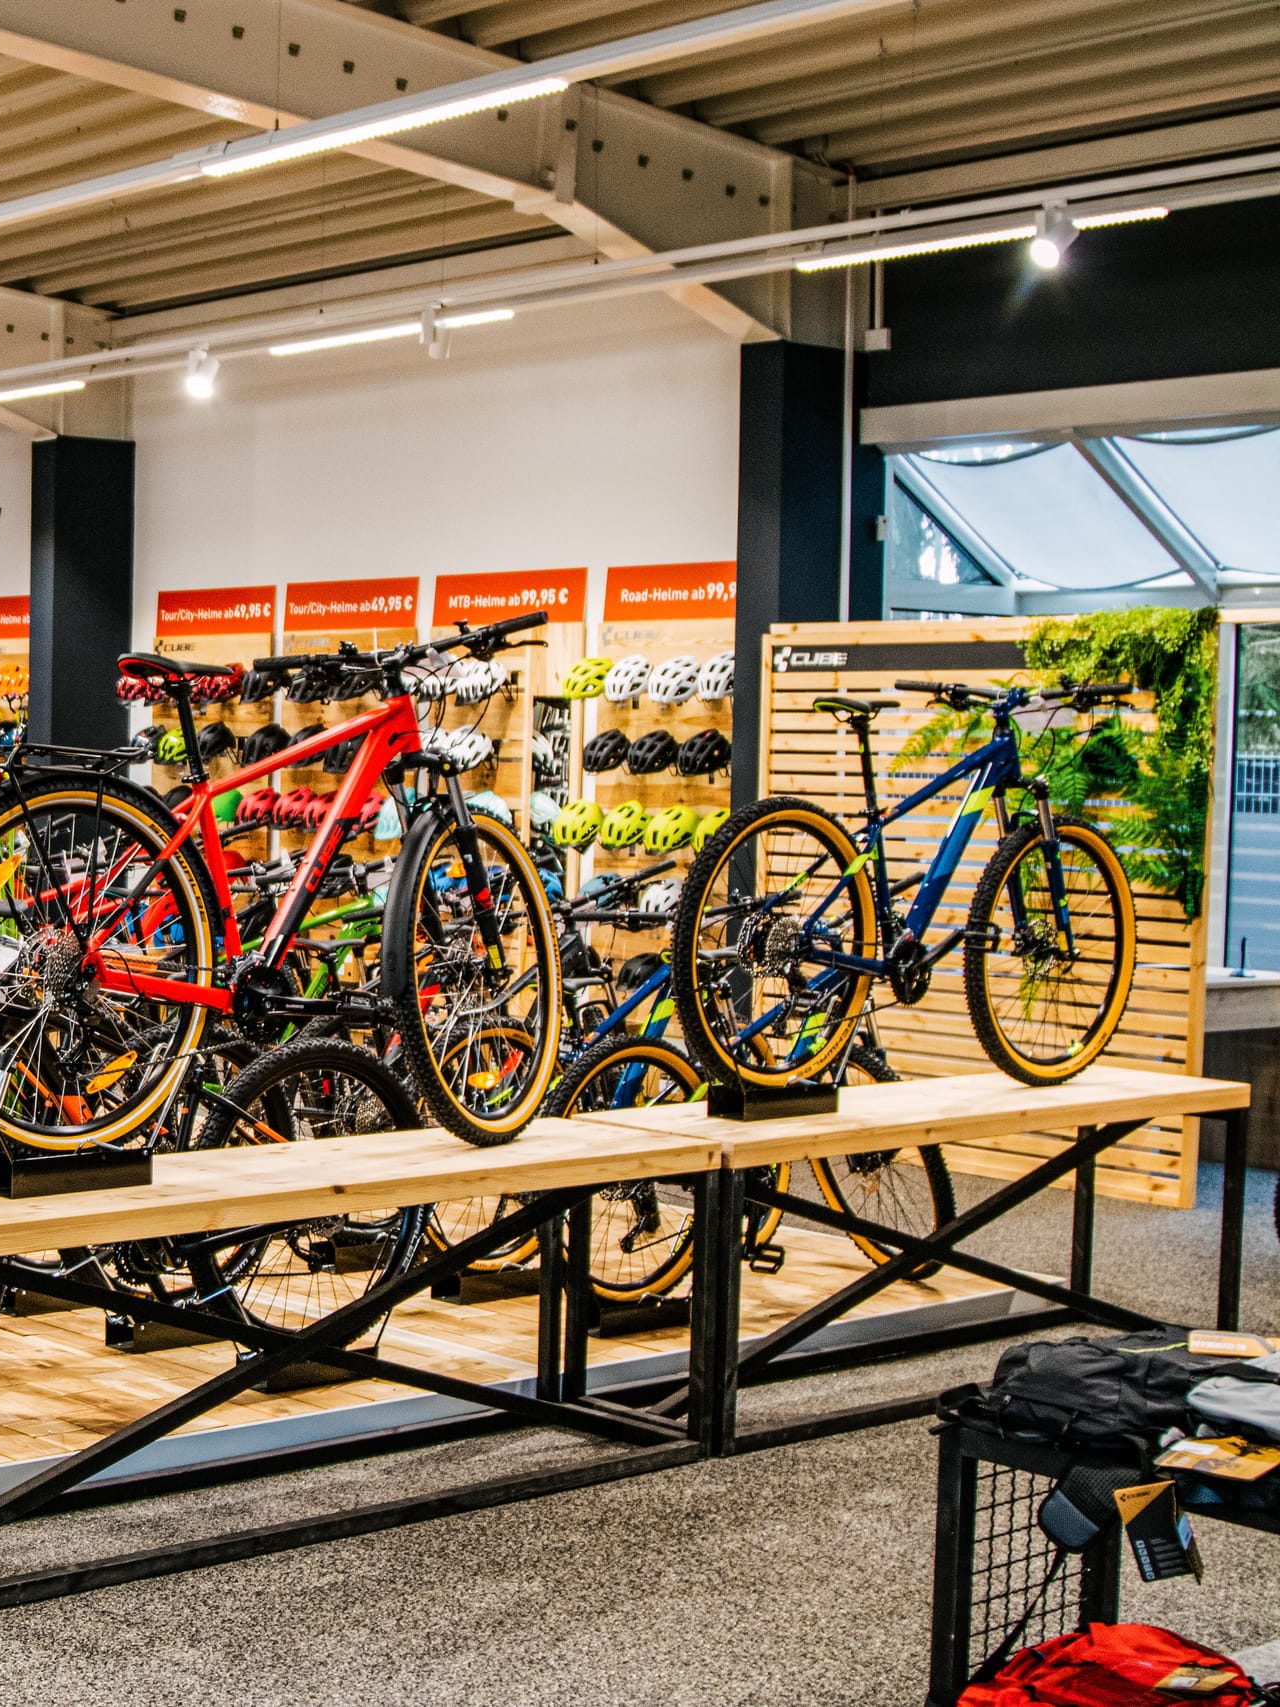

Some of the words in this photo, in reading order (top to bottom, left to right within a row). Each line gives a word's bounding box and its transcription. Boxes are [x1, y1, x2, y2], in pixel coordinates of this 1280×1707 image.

[449, 594, 506, 608] MTB-Helme
[508, 594, 520, 606] ab
[521, 589, 556, 608] 99,95
[558, 588, 568, 604] €
[621, 588, 689, 603] Road-Helme
[691, 588, 705, 600] ab
[161, 608, 222, 622] Tour/City-Helme
[223, 608, 234, 619] ab
[234, 604, 263, 620] 49,95
[263, 603, 271, 617] €
[289, 600, 358, 616] Tour/City-Helme
[359, 602, 370, 613] ab
[370, 597, 402, 614] 49,95
[403, 595, 413, 610] €
[790, 652, 848, 666] CUBE
[305, 823, 344, 893] CUBE
